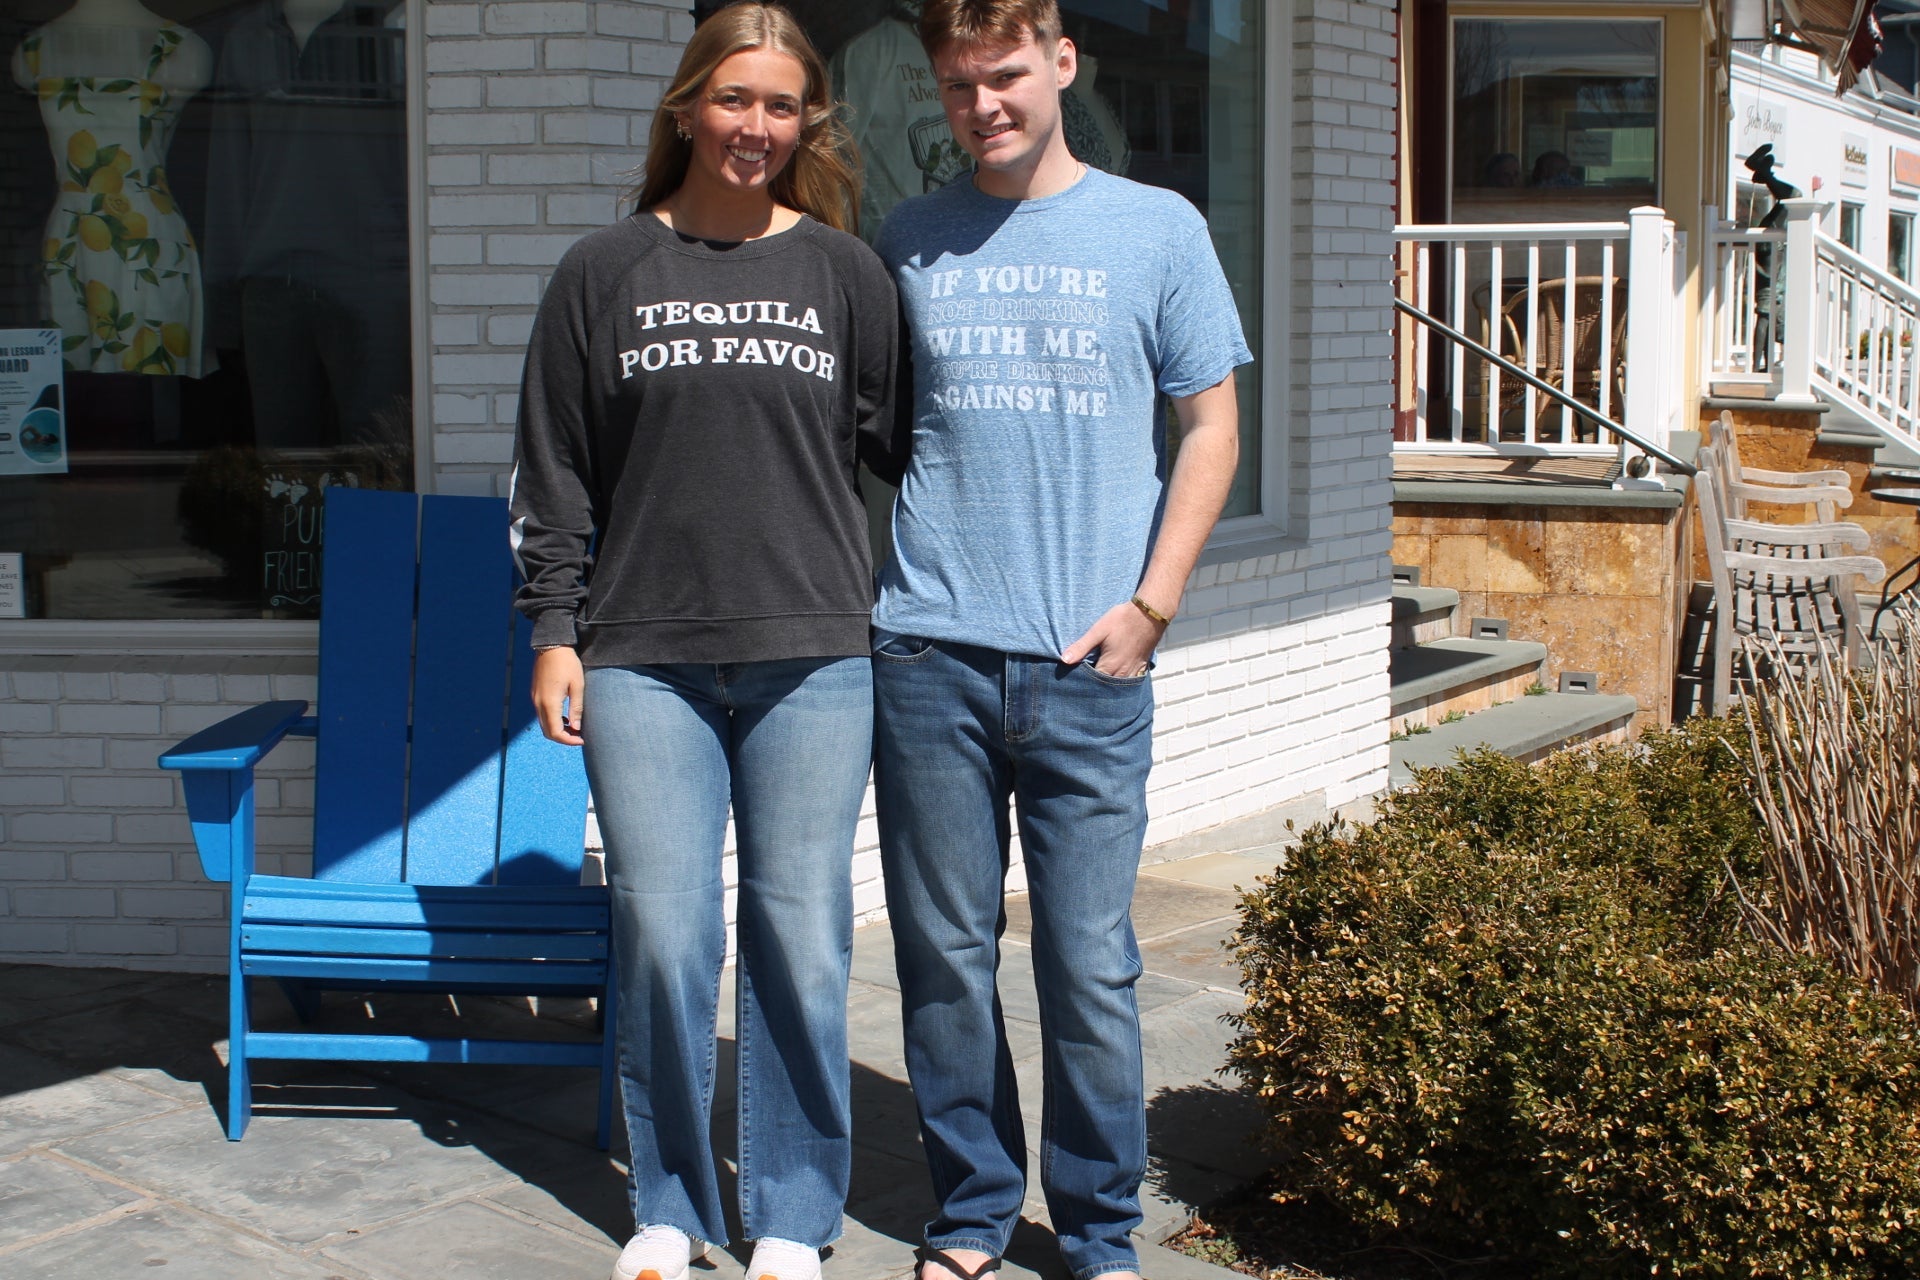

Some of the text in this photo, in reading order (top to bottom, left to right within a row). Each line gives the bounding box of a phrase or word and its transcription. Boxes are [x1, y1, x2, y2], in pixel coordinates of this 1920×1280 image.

[896, 62, 928, 81] The
[930, 265, 1107, 298] IF YOU'RE
[636, 301, 824, 334] TEQUILA
[927, 299, 1109, 326] NOT DRINKING
[11, 346, 45, 356] LESSONS
[619, 337, 836, 381] POR FAVOR
[926, 326, 1107, 367] WITH ME,
[931, 361, 1108, 386] YOU'RE DRINKING
[933, 385, 1107, 417] AGAINST ME
